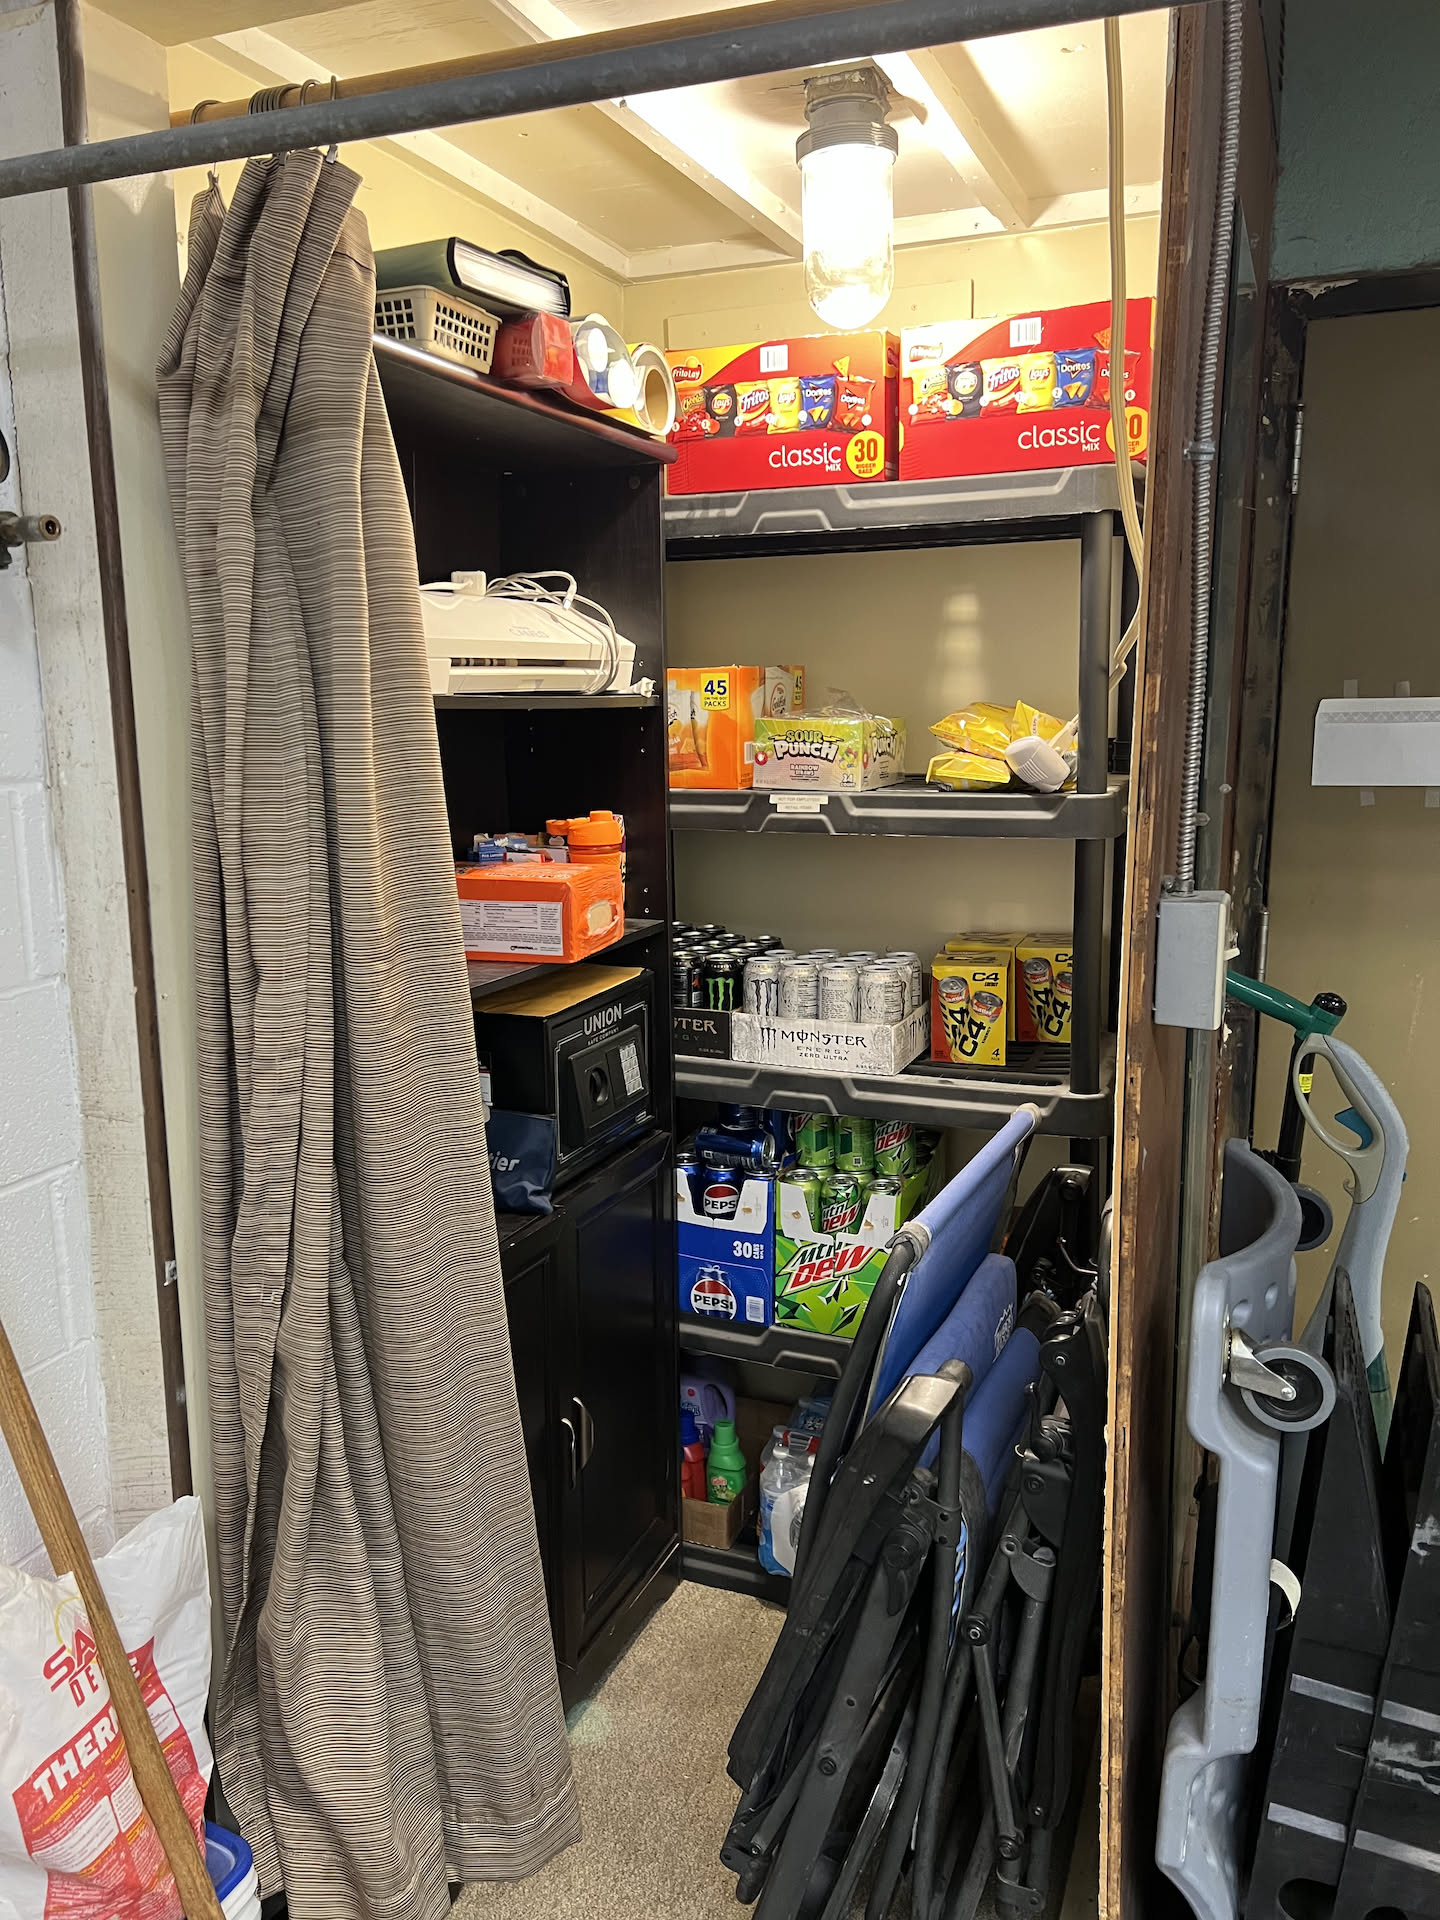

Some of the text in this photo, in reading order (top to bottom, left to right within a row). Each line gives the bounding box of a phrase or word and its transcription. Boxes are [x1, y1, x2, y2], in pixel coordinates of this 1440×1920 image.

[1061, 362, 1091, 374] Doritos
[987, 366, 1020, 392] Fritos
[740, 389, 770, 412] Fritos
[805, 388, 832, 399] Doritos
[840, 394, 866, 405] Doritos
[1017, 420, 1101, 450] classic
[768, 442, 842, 468] classic
[854, 438, 879, 463] 30
[1081, 442, 1100, 452] MIX
[825, 463, 842, 472] MIX
[704, 680, 728, 696] 45
[785, 730, 824, 743] SOUR
[773, 740, 839, 763] PUNCH
[971, 972, 1000, 982] C4
[583, 1003, 622, 1036] UNION
[781, 1029, 868, 1048] MONSTER
[796, 1046, 850, 1054] ENERGY
[992, 1048, 1000, 1057] 4
[732, 1240, 753, 1259] 30
[693, 1293, 734, 1310] PEPSI
[32, 1705, 119, 1803] THER
